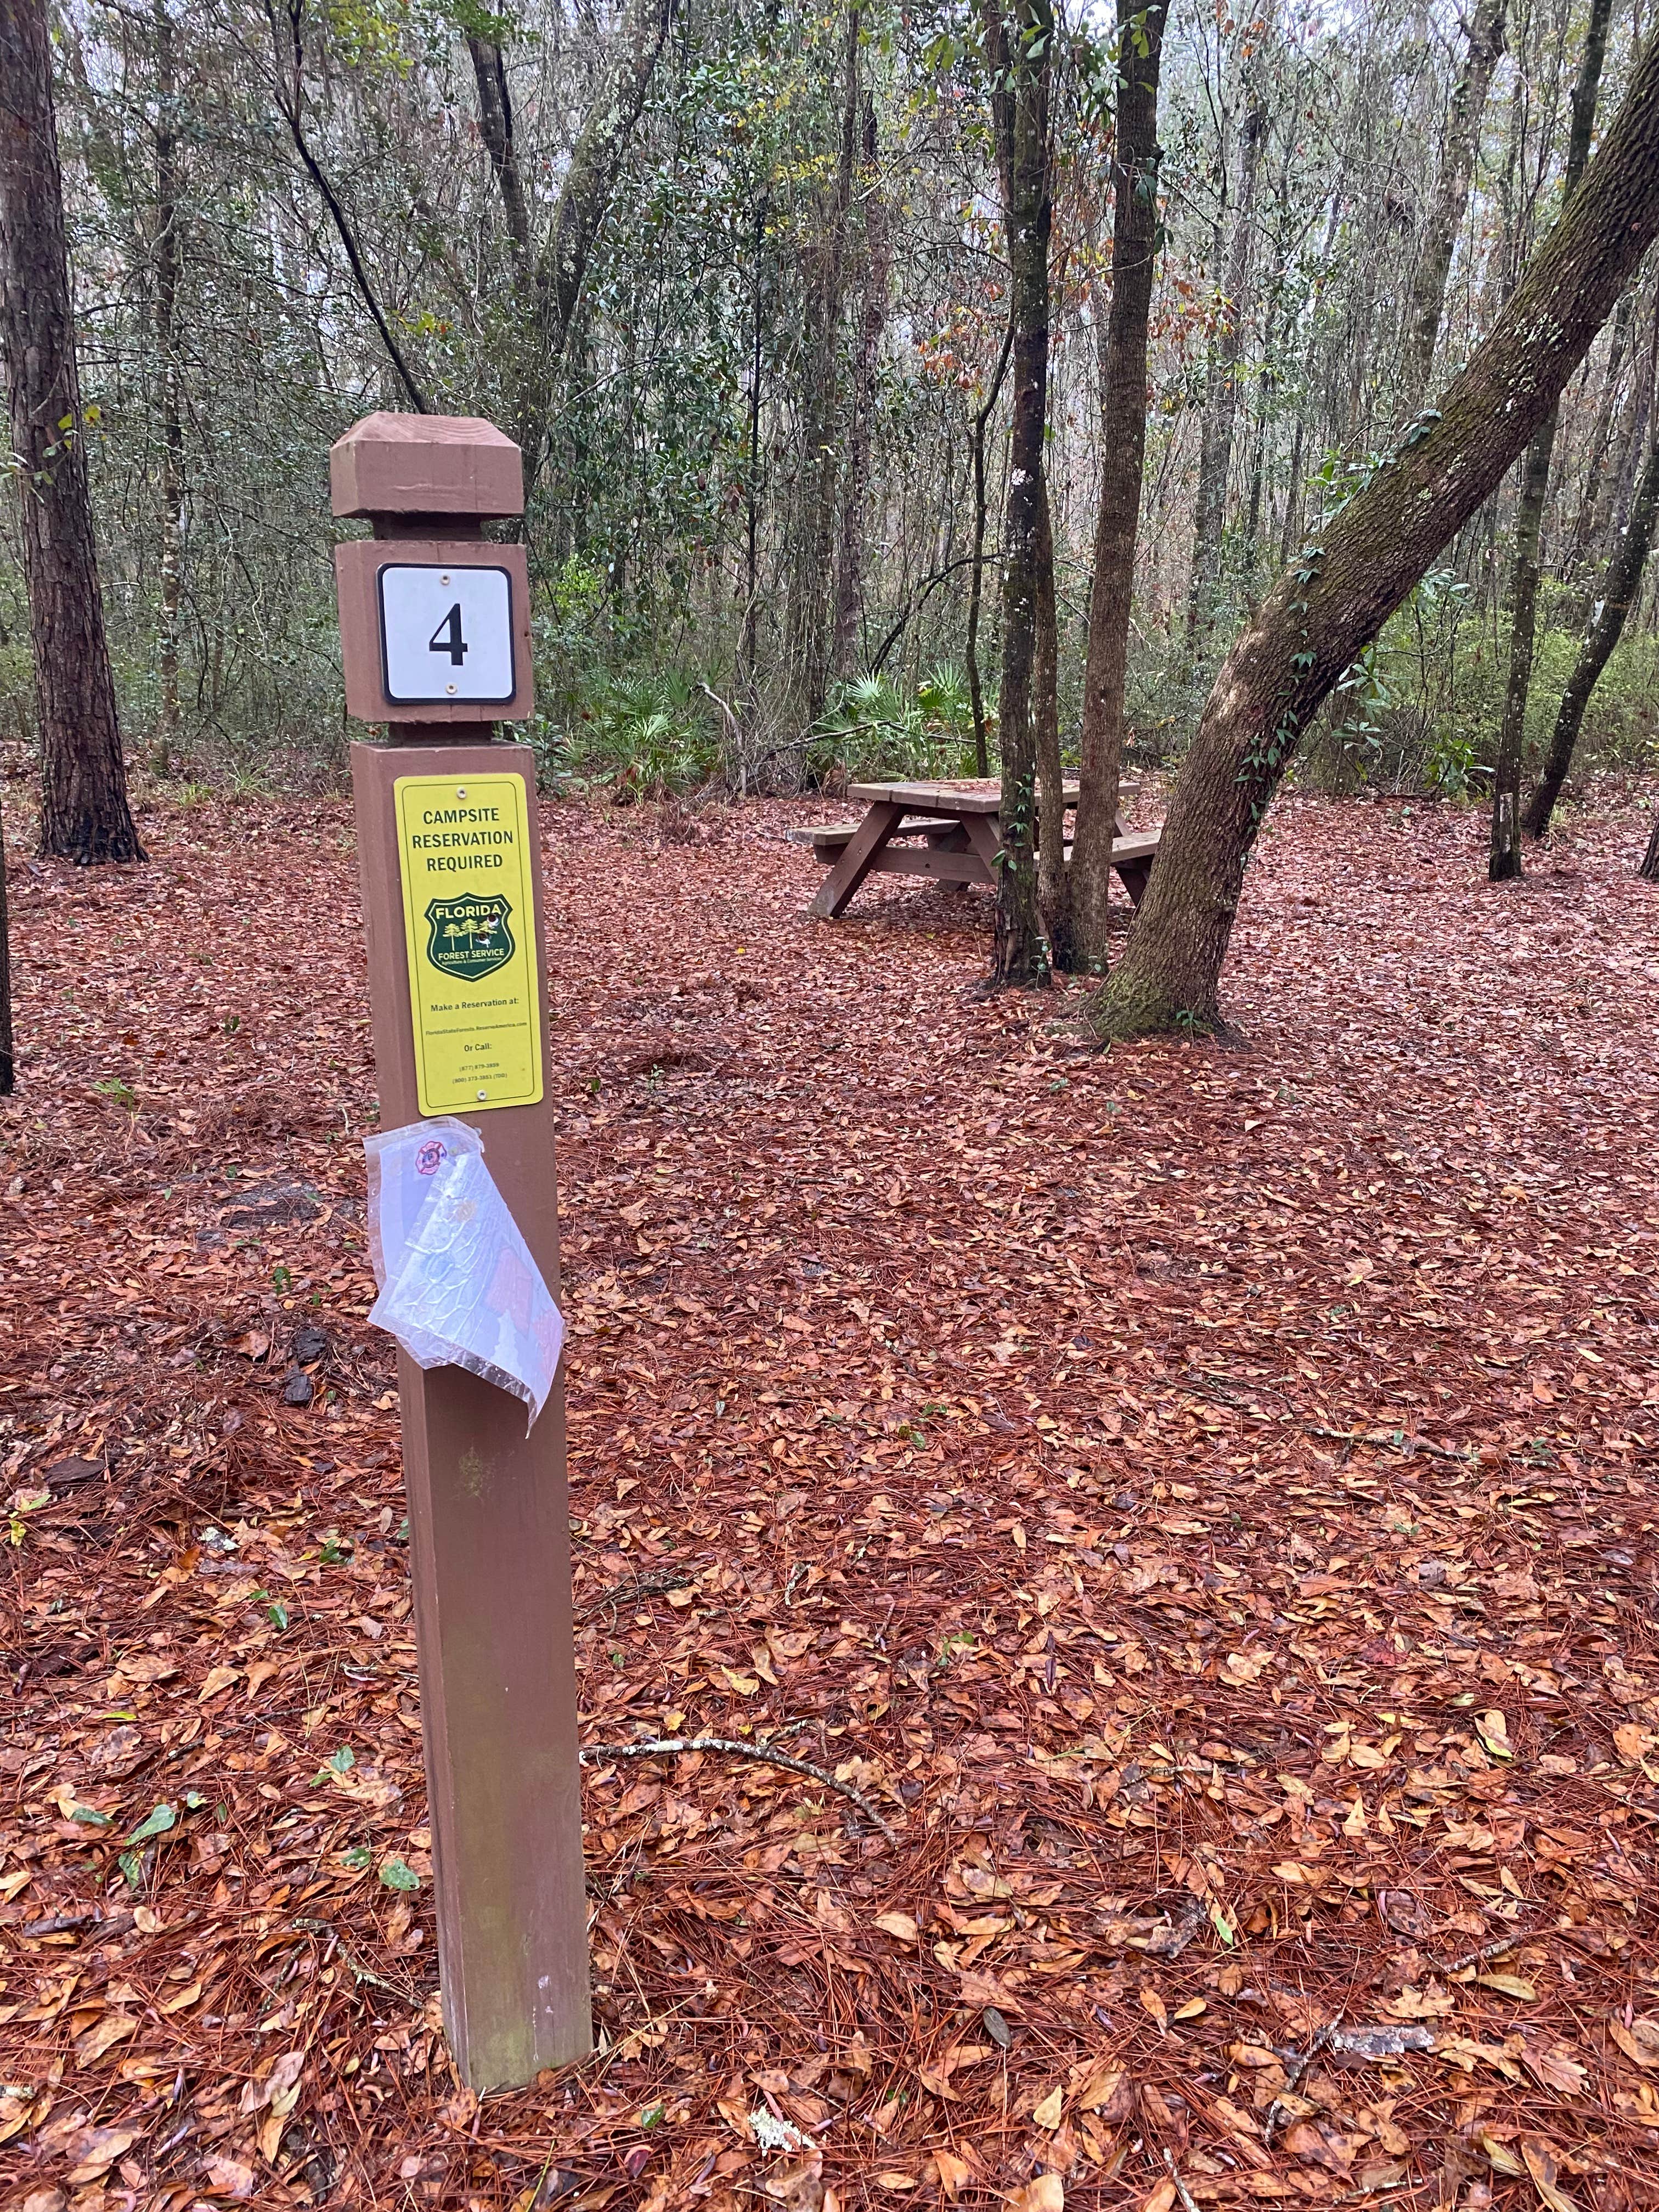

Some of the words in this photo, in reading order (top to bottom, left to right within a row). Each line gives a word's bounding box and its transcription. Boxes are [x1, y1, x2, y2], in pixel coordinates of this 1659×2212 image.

[429, 603, 468, 665] 4
[423, 808, 500, 825] CAMPSITE
[412, 831, 514, 848] RESERVATION
[427, 854, 503, 872] REQUIRED
[436, 904, 502, 919] FLORIDA
[438, 951, 469, 960] FOREST
[471, 949, 504, 957] SERVICE
[461, 998, 507, 1008] Reservation
